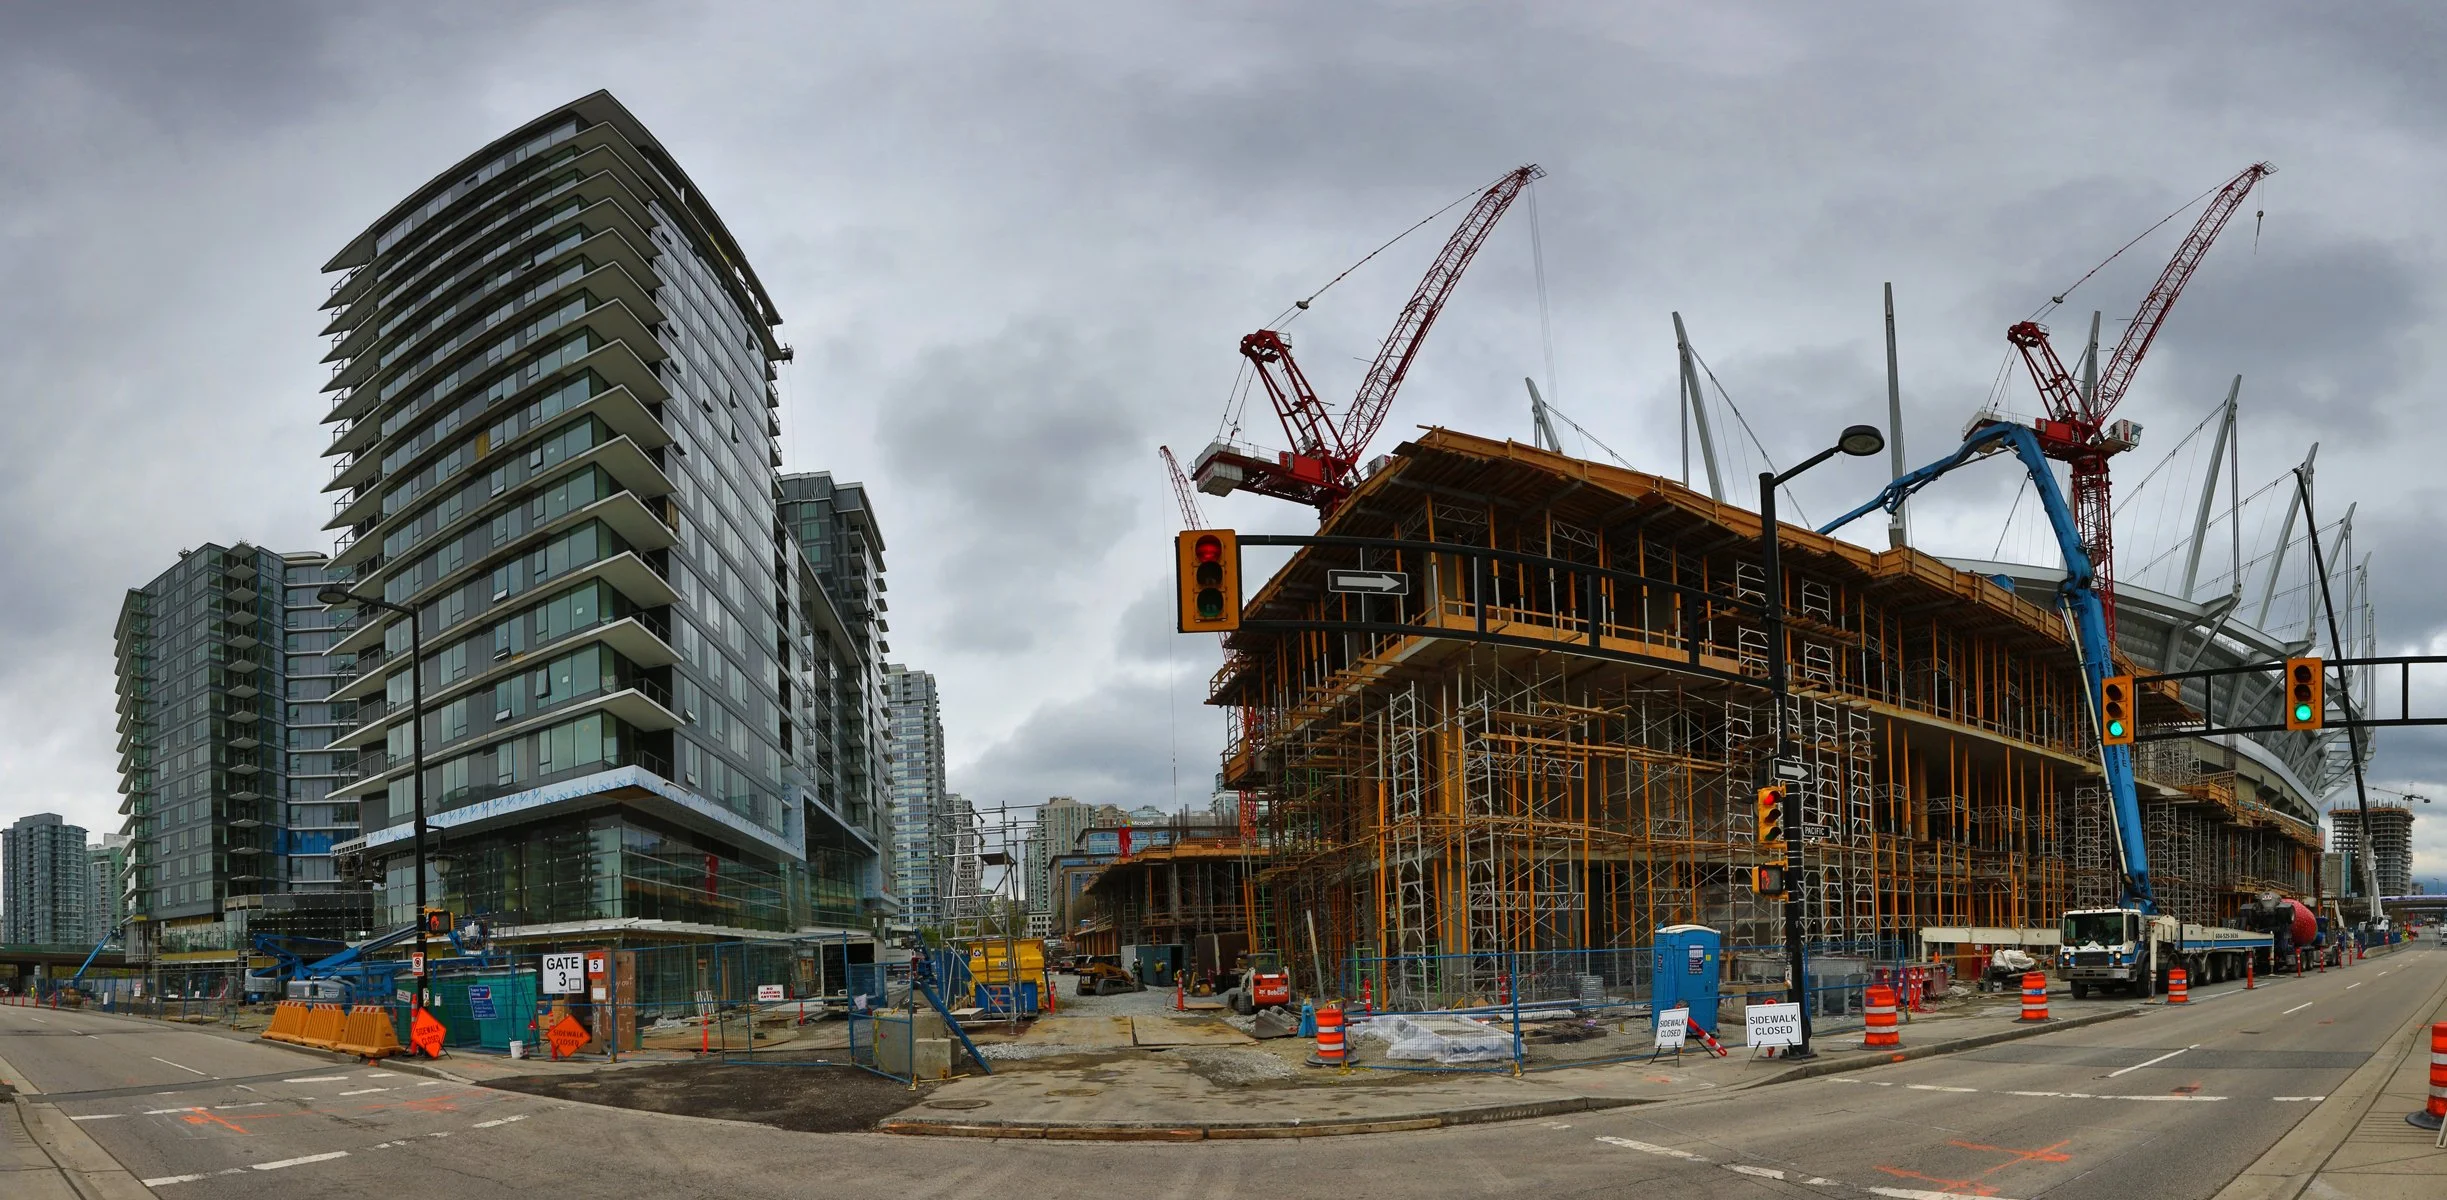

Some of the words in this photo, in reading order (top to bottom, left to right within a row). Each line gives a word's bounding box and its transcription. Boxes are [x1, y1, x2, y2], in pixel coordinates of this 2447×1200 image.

[1804, 826, 1825, 835] PACIFIC
[546, 957, 579, 969] GATE
[593, 960, 599, 969] 5
[558, 971, 567, 986] 3
[1659, 1018, 1685, 1028] SIDEWALK
[1749, 1014, 1797, 1024] SIDEWALK
[415, 1024, 439, 1036] SIDEWALK
[553, 1029, 584, 1038] SIDEWALK
[1660, 1030, 1682, 1038] CLOSED
[1755, 1026, 1793, 1035] CLOSED
[421, 1035, 441, 1046] CLOSED
[556, 1039, 580, 1048] CLOSED
